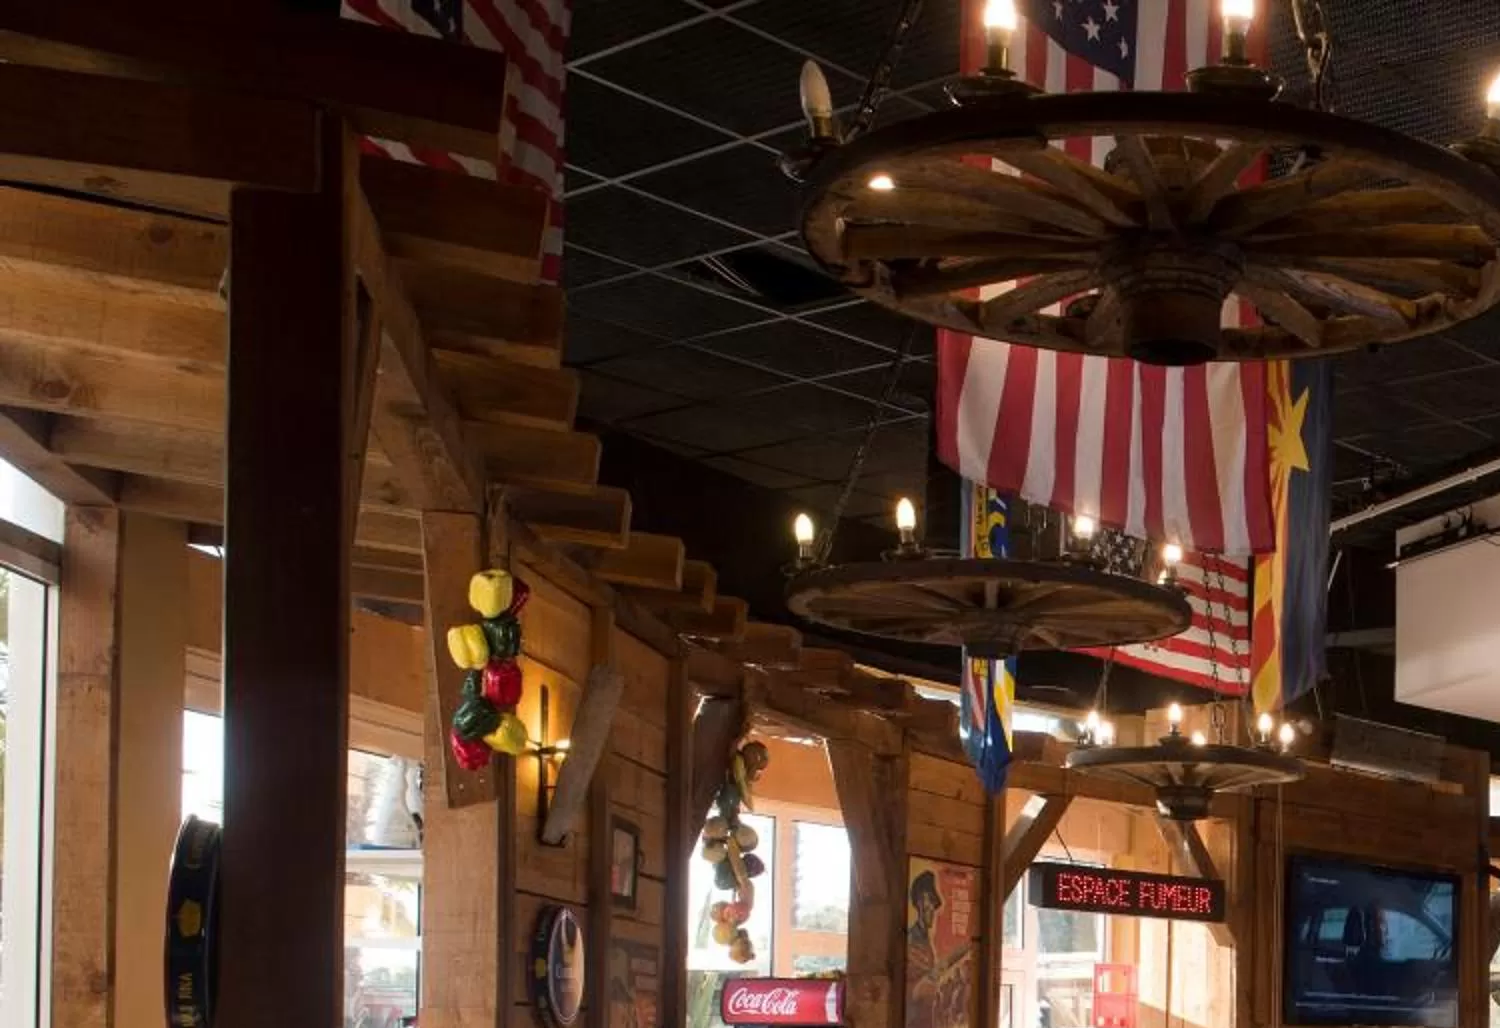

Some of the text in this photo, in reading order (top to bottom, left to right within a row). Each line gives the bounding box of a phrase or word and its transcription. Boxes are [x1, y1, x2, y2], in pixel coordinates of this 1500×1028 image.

[1058, 873, 1212, 913] ESPACE FUMEUR
[728, 987, 800, 1015] Coca-Cola
